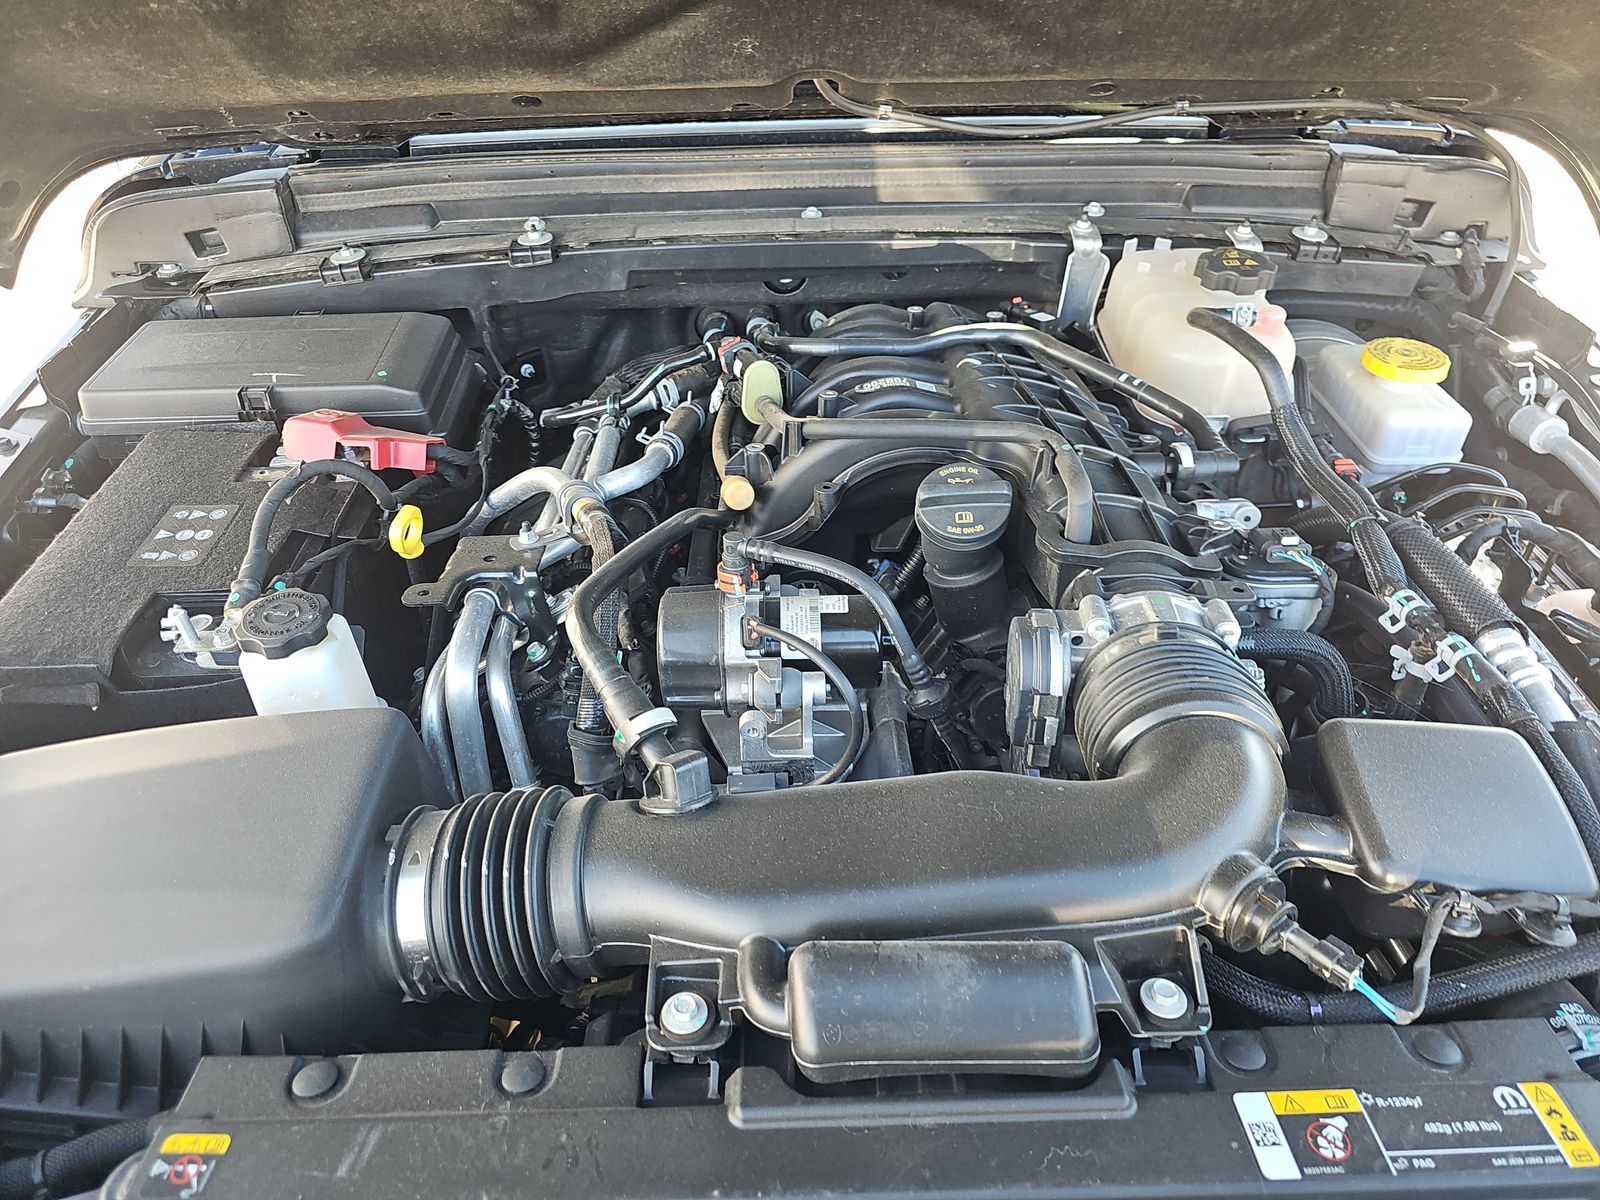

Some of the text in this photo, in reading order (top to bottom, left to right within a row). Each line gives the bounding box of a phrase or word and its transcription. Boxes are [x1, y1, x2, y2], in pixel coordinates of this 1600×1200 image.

[939, 466, 979, 477] ENGINE OIL
[946, 524, 985, 534] SAE 0W-20
[1559, 1003, 1585, 1015] RAD
[1375, 1096, 1423, 1109] R-1234yf
